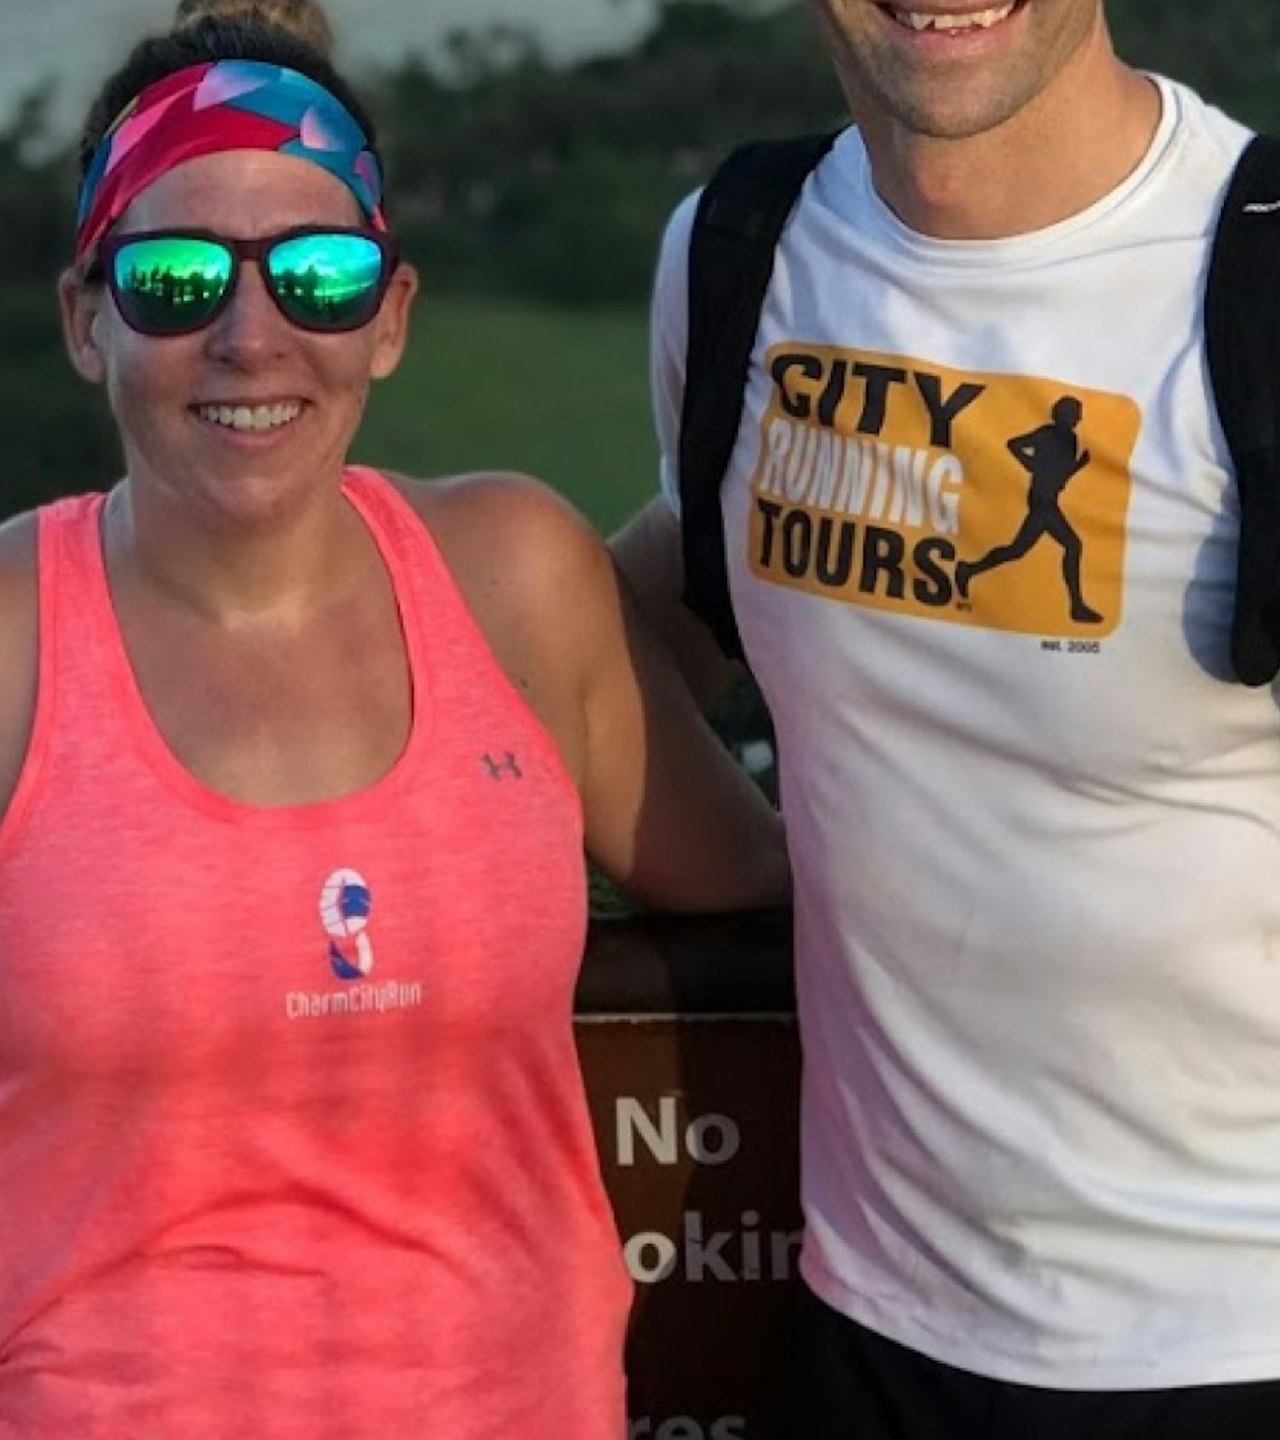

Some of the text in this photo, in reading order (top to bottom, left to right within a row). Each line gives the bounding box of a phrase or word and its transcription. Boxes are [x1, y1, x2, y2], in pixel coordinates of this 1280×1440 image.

[771, 353, 986, 448] CITY
[758, 418, 964, 534] RUNNING
[756, 497, 956, 607] TOURS
[615, 1096, 740, 1166] No
